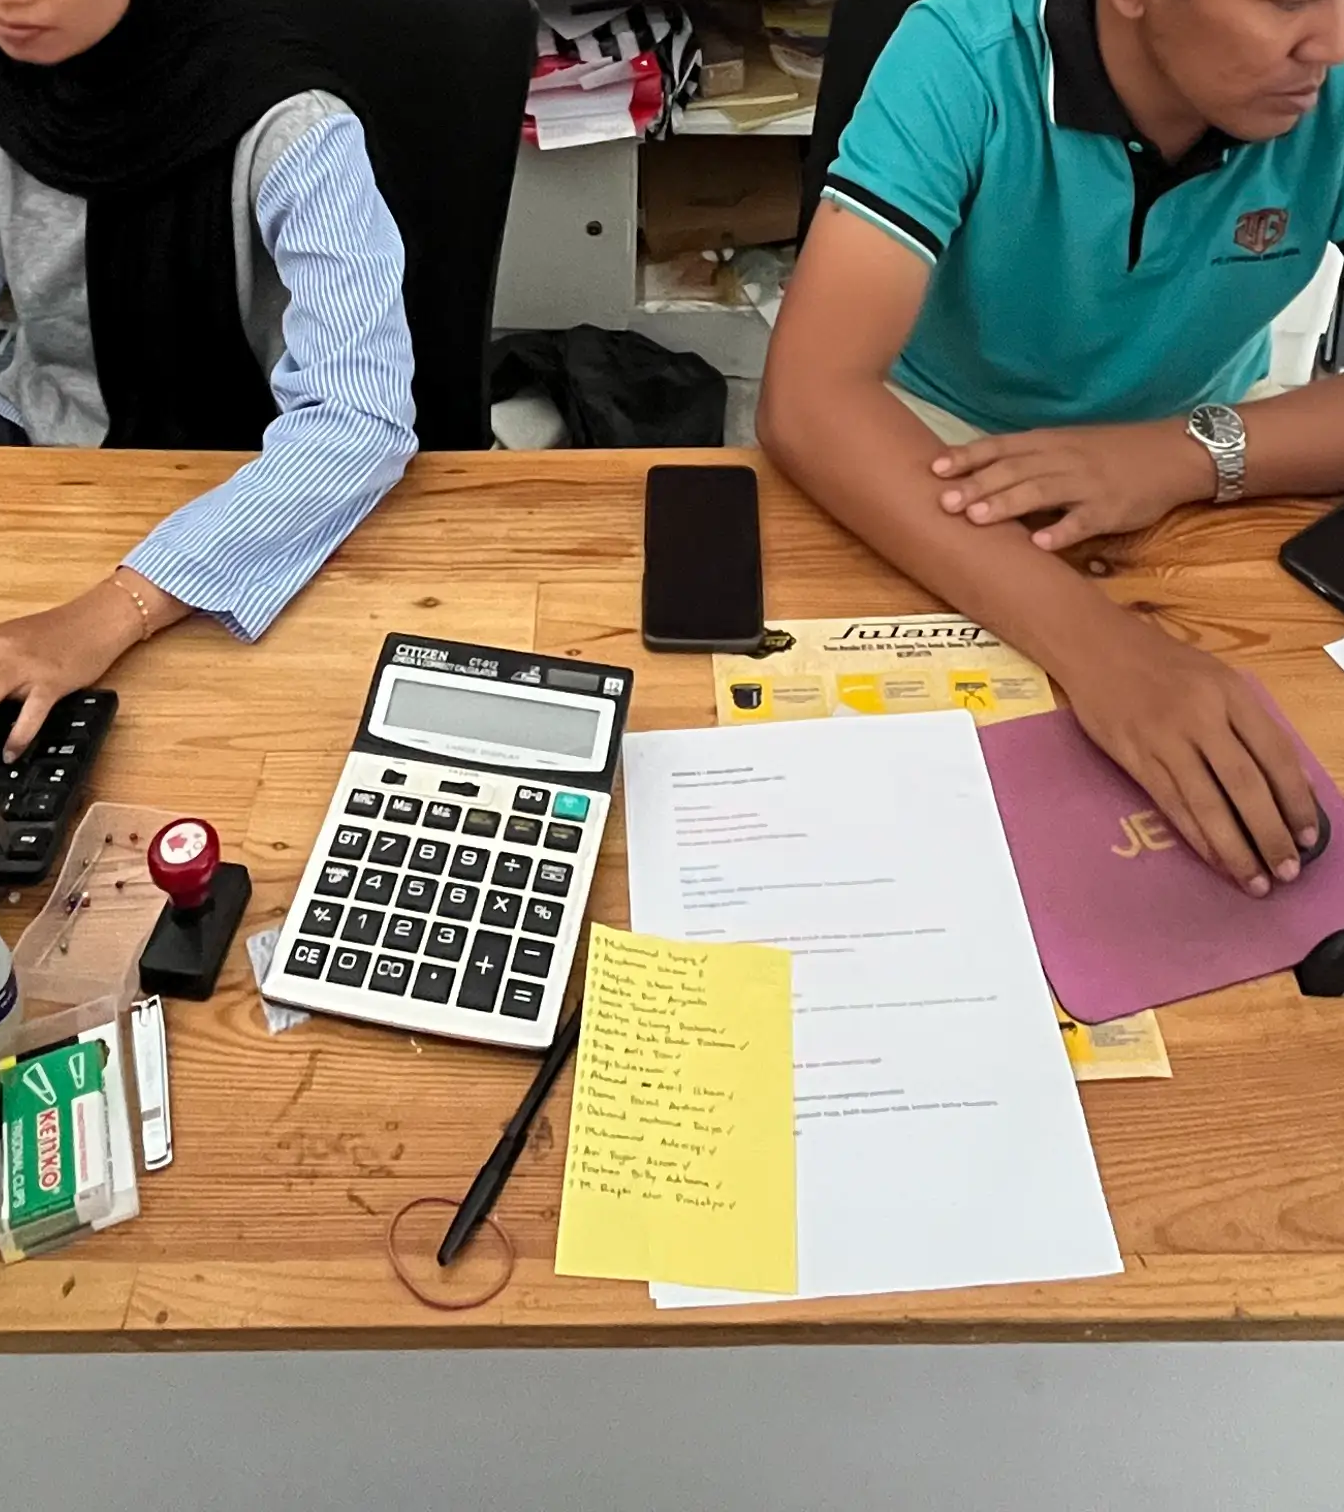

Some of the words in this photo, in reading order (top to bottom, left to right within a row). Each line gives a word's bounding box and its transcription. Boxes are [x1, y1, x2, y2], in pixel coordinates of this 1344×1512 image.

[828, 623, 985, 641] Julang
[395, 643, 450, 661] CITIZEN
[338, 830, 363, 847] GT
[380, 837, 398, 852] 7
[418, 844, 438, 860] 8
[459, 850, 479, 867] 9
[365, 874, 382, 889] 4
[406, 880, 426, 896] 5
[449, 888, 468, 904] 6
[357, 913, 367, 929] 1
[394, 919, 414, 936] 2
[436, 926, 457, 944] 3
[294, 944, 322, 965] CE
[376, 959, 405, 978] 00
